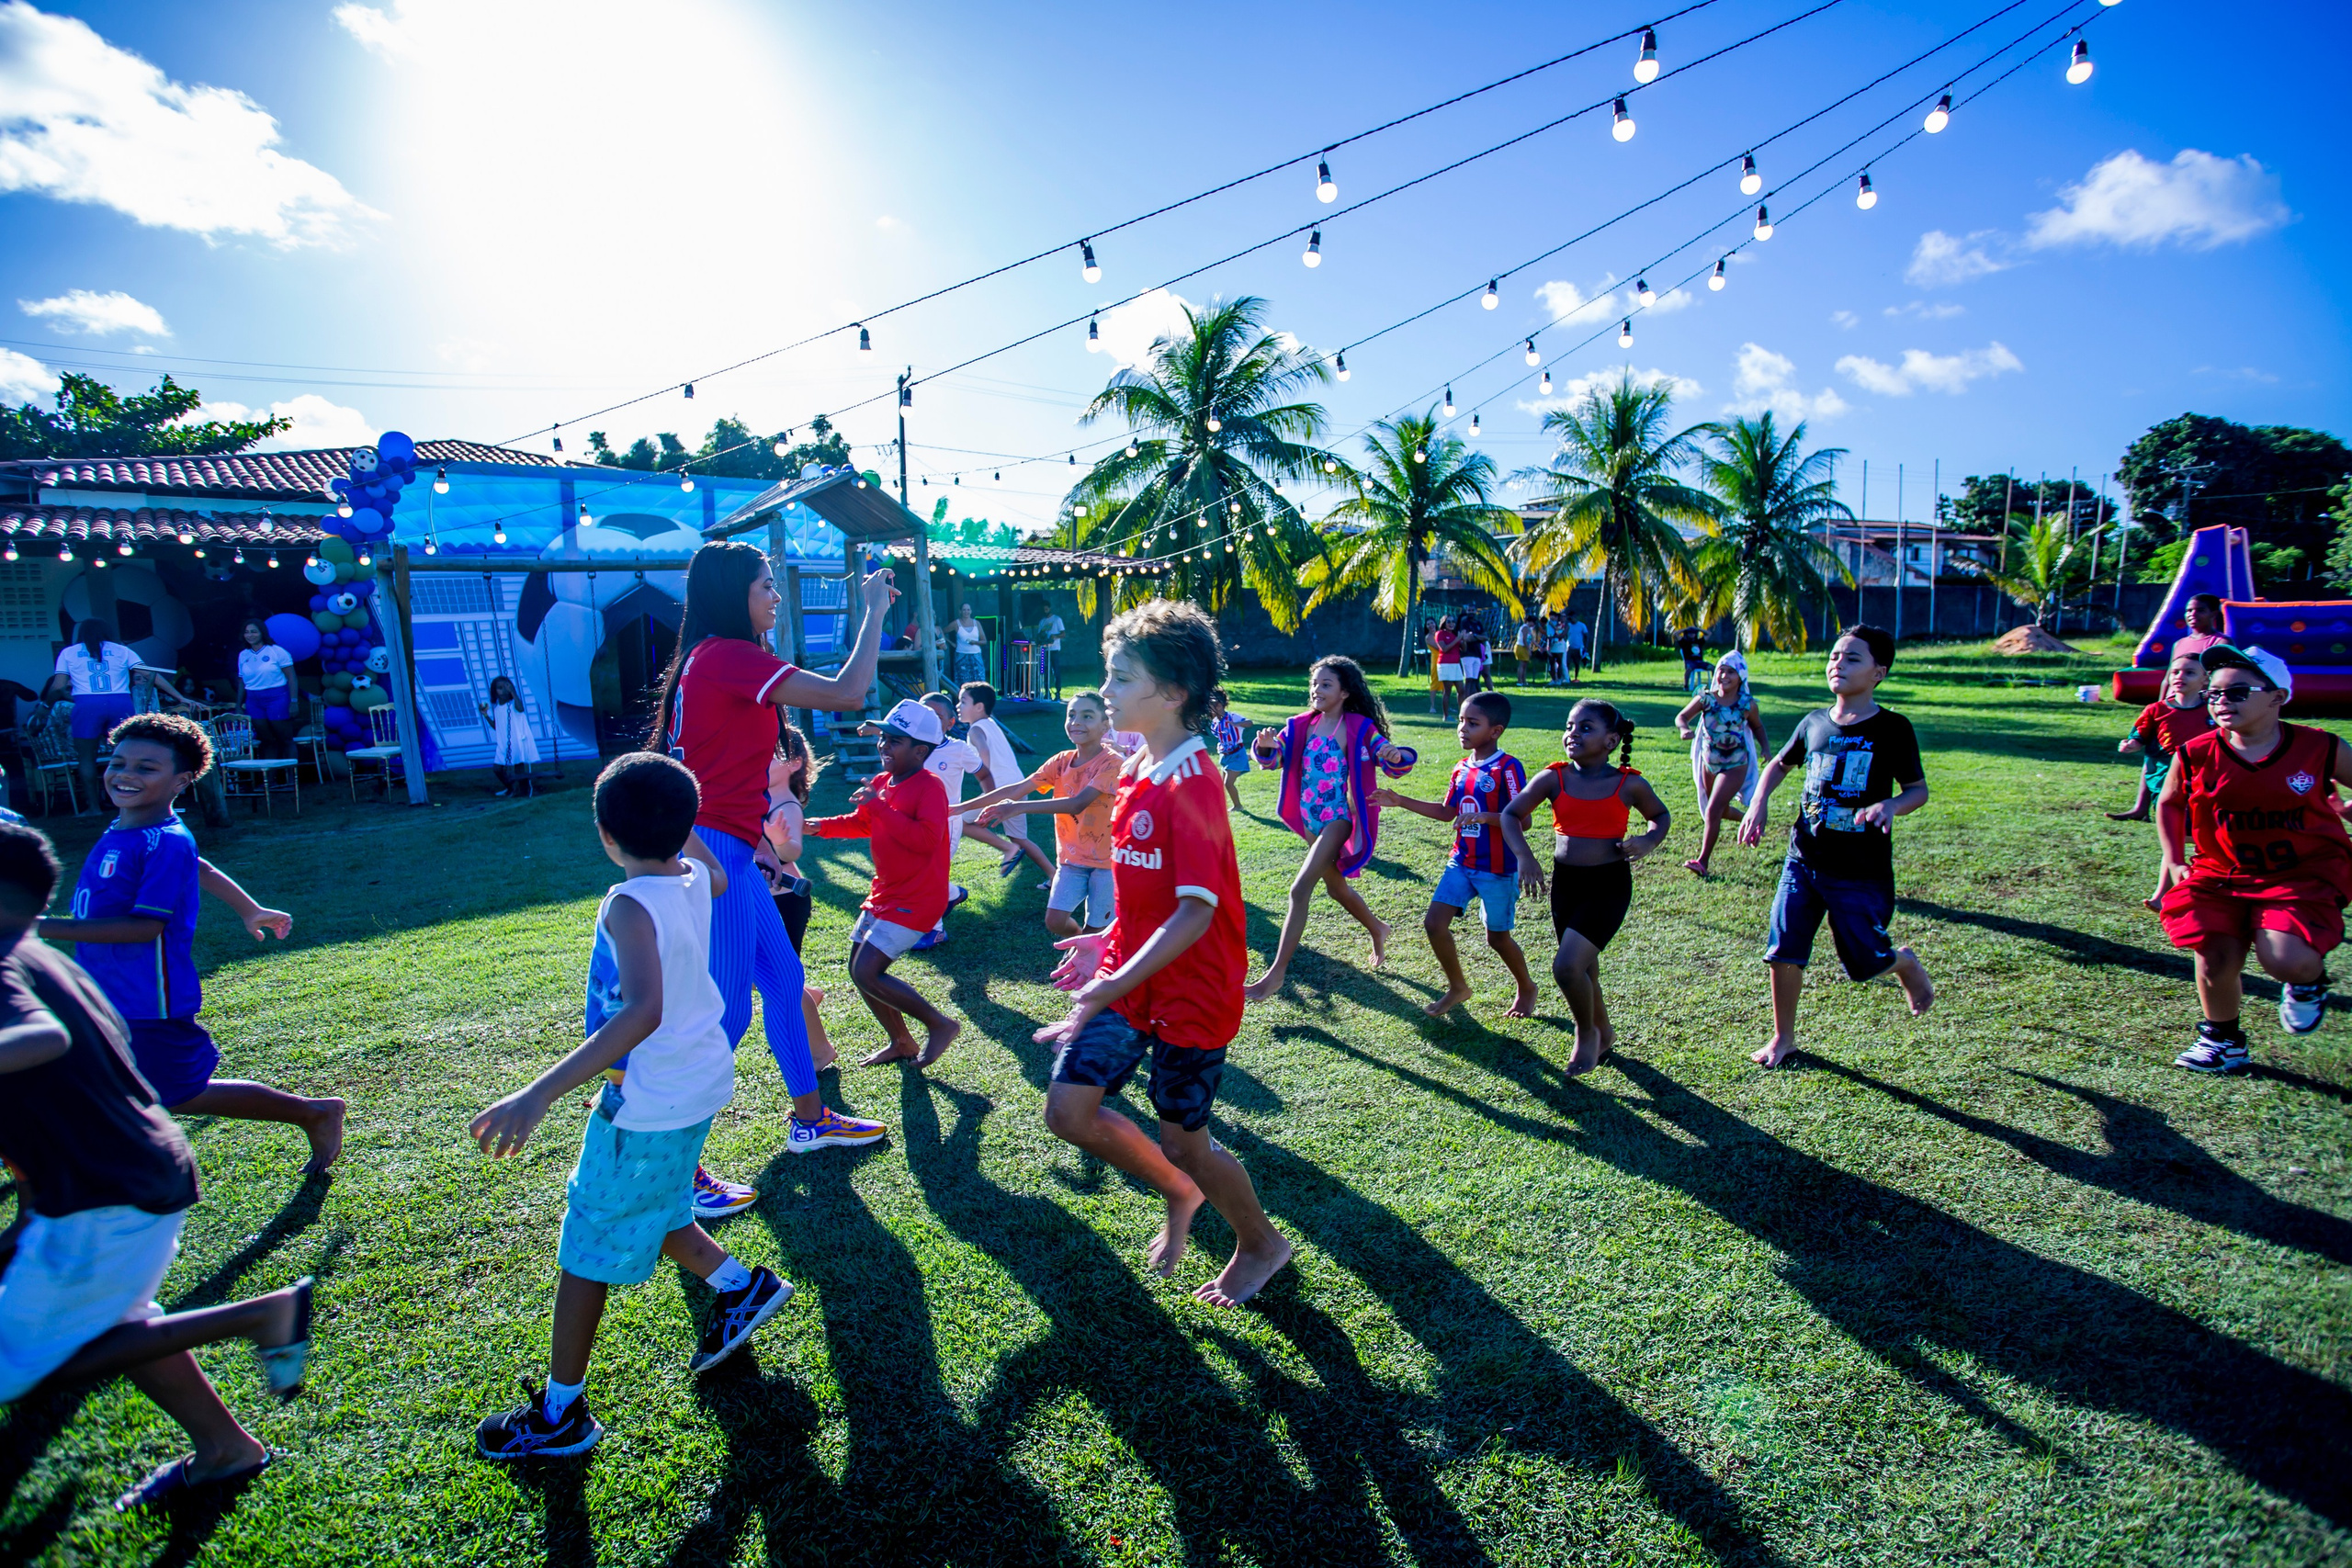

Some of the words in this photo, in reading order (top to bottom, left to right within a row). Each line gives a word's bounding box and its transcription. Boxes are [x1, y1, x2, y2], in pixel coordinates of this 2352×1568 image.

[87, 660, 111, 693] 8
[1505, 770, 1520, 800] NETSHO
[2236, 840, 2301, 874] 99
